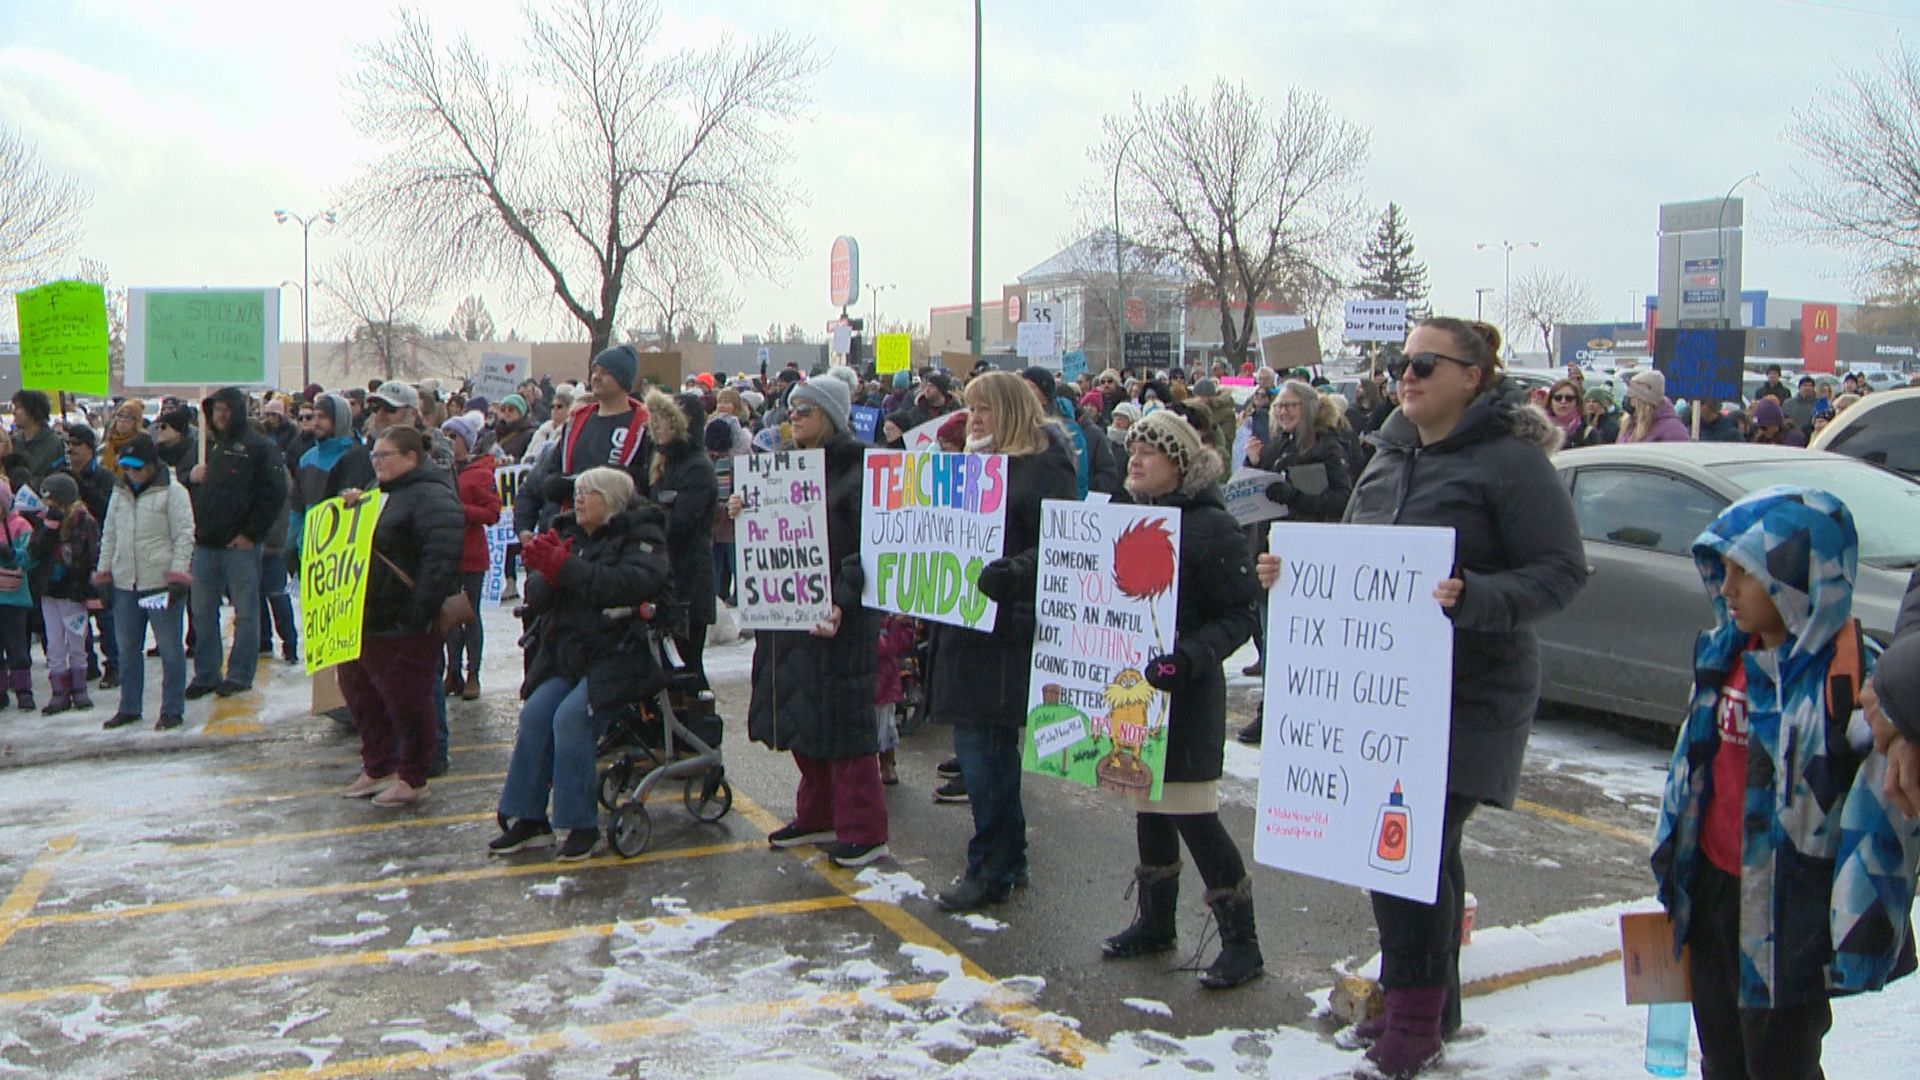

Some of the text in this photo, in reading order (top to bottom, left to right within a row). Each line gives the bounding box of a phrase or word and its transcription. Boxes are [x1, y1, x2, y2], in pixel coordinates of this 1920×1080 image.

[1346, 321, 1405, 332] Our Future
[1352, 305, 1399, 315] Invest in
[790, 480, 821, 505] 8th
[867, 453, 1003, 514] TEACHERS
[305, 496, 372, 561] NOT
[777, 516, 814, 547] Pupil
[871, 510, 1002, 553] JUST WANNA HAVE
[1040, 508, 1102, 543] UNLESS
[307, 547, 366, 601] really
[1045, 548, 1100, 571] SOMEONE
[1043, 571, 1113, 605] LIKE YOU
[1290, 554, 1423, 604] YOU CAN'T
[319, 593, 354, 638] option
[1041, 598, 1143, 633] CARES AN AWFUL
[1038, 624, 1159, 666] LOT, NOTHING IS
[1289, 616, 1394, 651] FIX THIS
[1034, 652, 1111, 684] GOING TO GET
[1288, 664, 1410, 708] WITH GLUE
[1119, 721, 1148, 747] NOT!
[1279, 714, 1409, 765] (WE'VE GOT
[1286, 764, 1350, 806] NONE)
